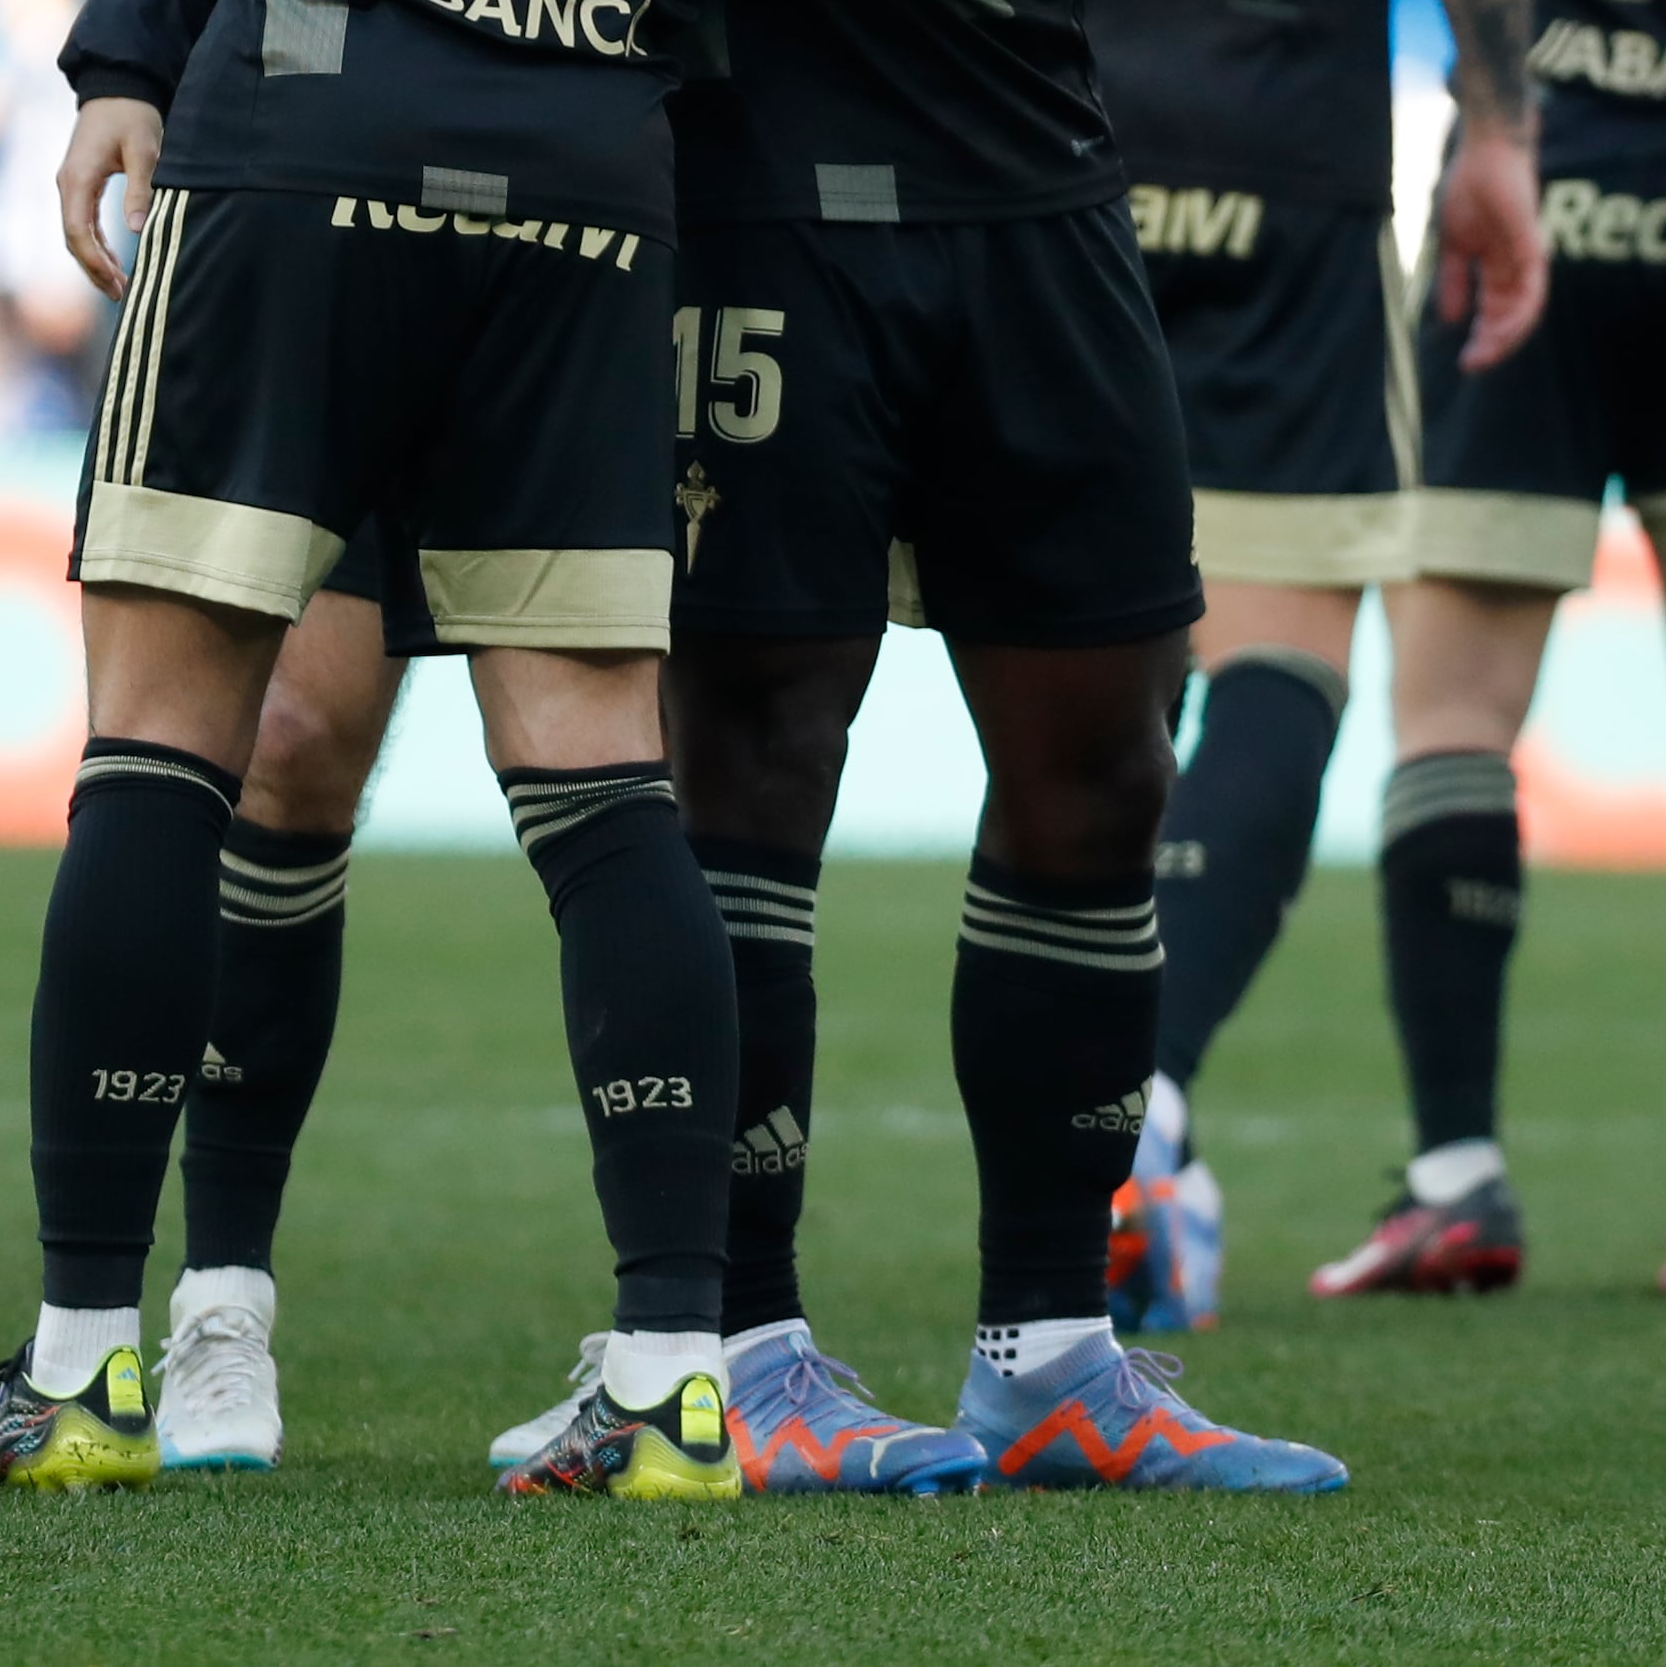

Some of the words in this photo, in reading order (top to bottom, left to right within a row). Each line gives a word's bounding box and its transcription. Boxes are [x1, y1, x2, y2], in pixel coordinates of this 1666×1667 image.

[672, 306, 786, 444] 15
[1154, 840, 1207, 880] 23
[91, 1068, 186, 1104] 1923
[592, 1075, 694, 1119] 1923
[731, 1141, 810, 1175] didas
